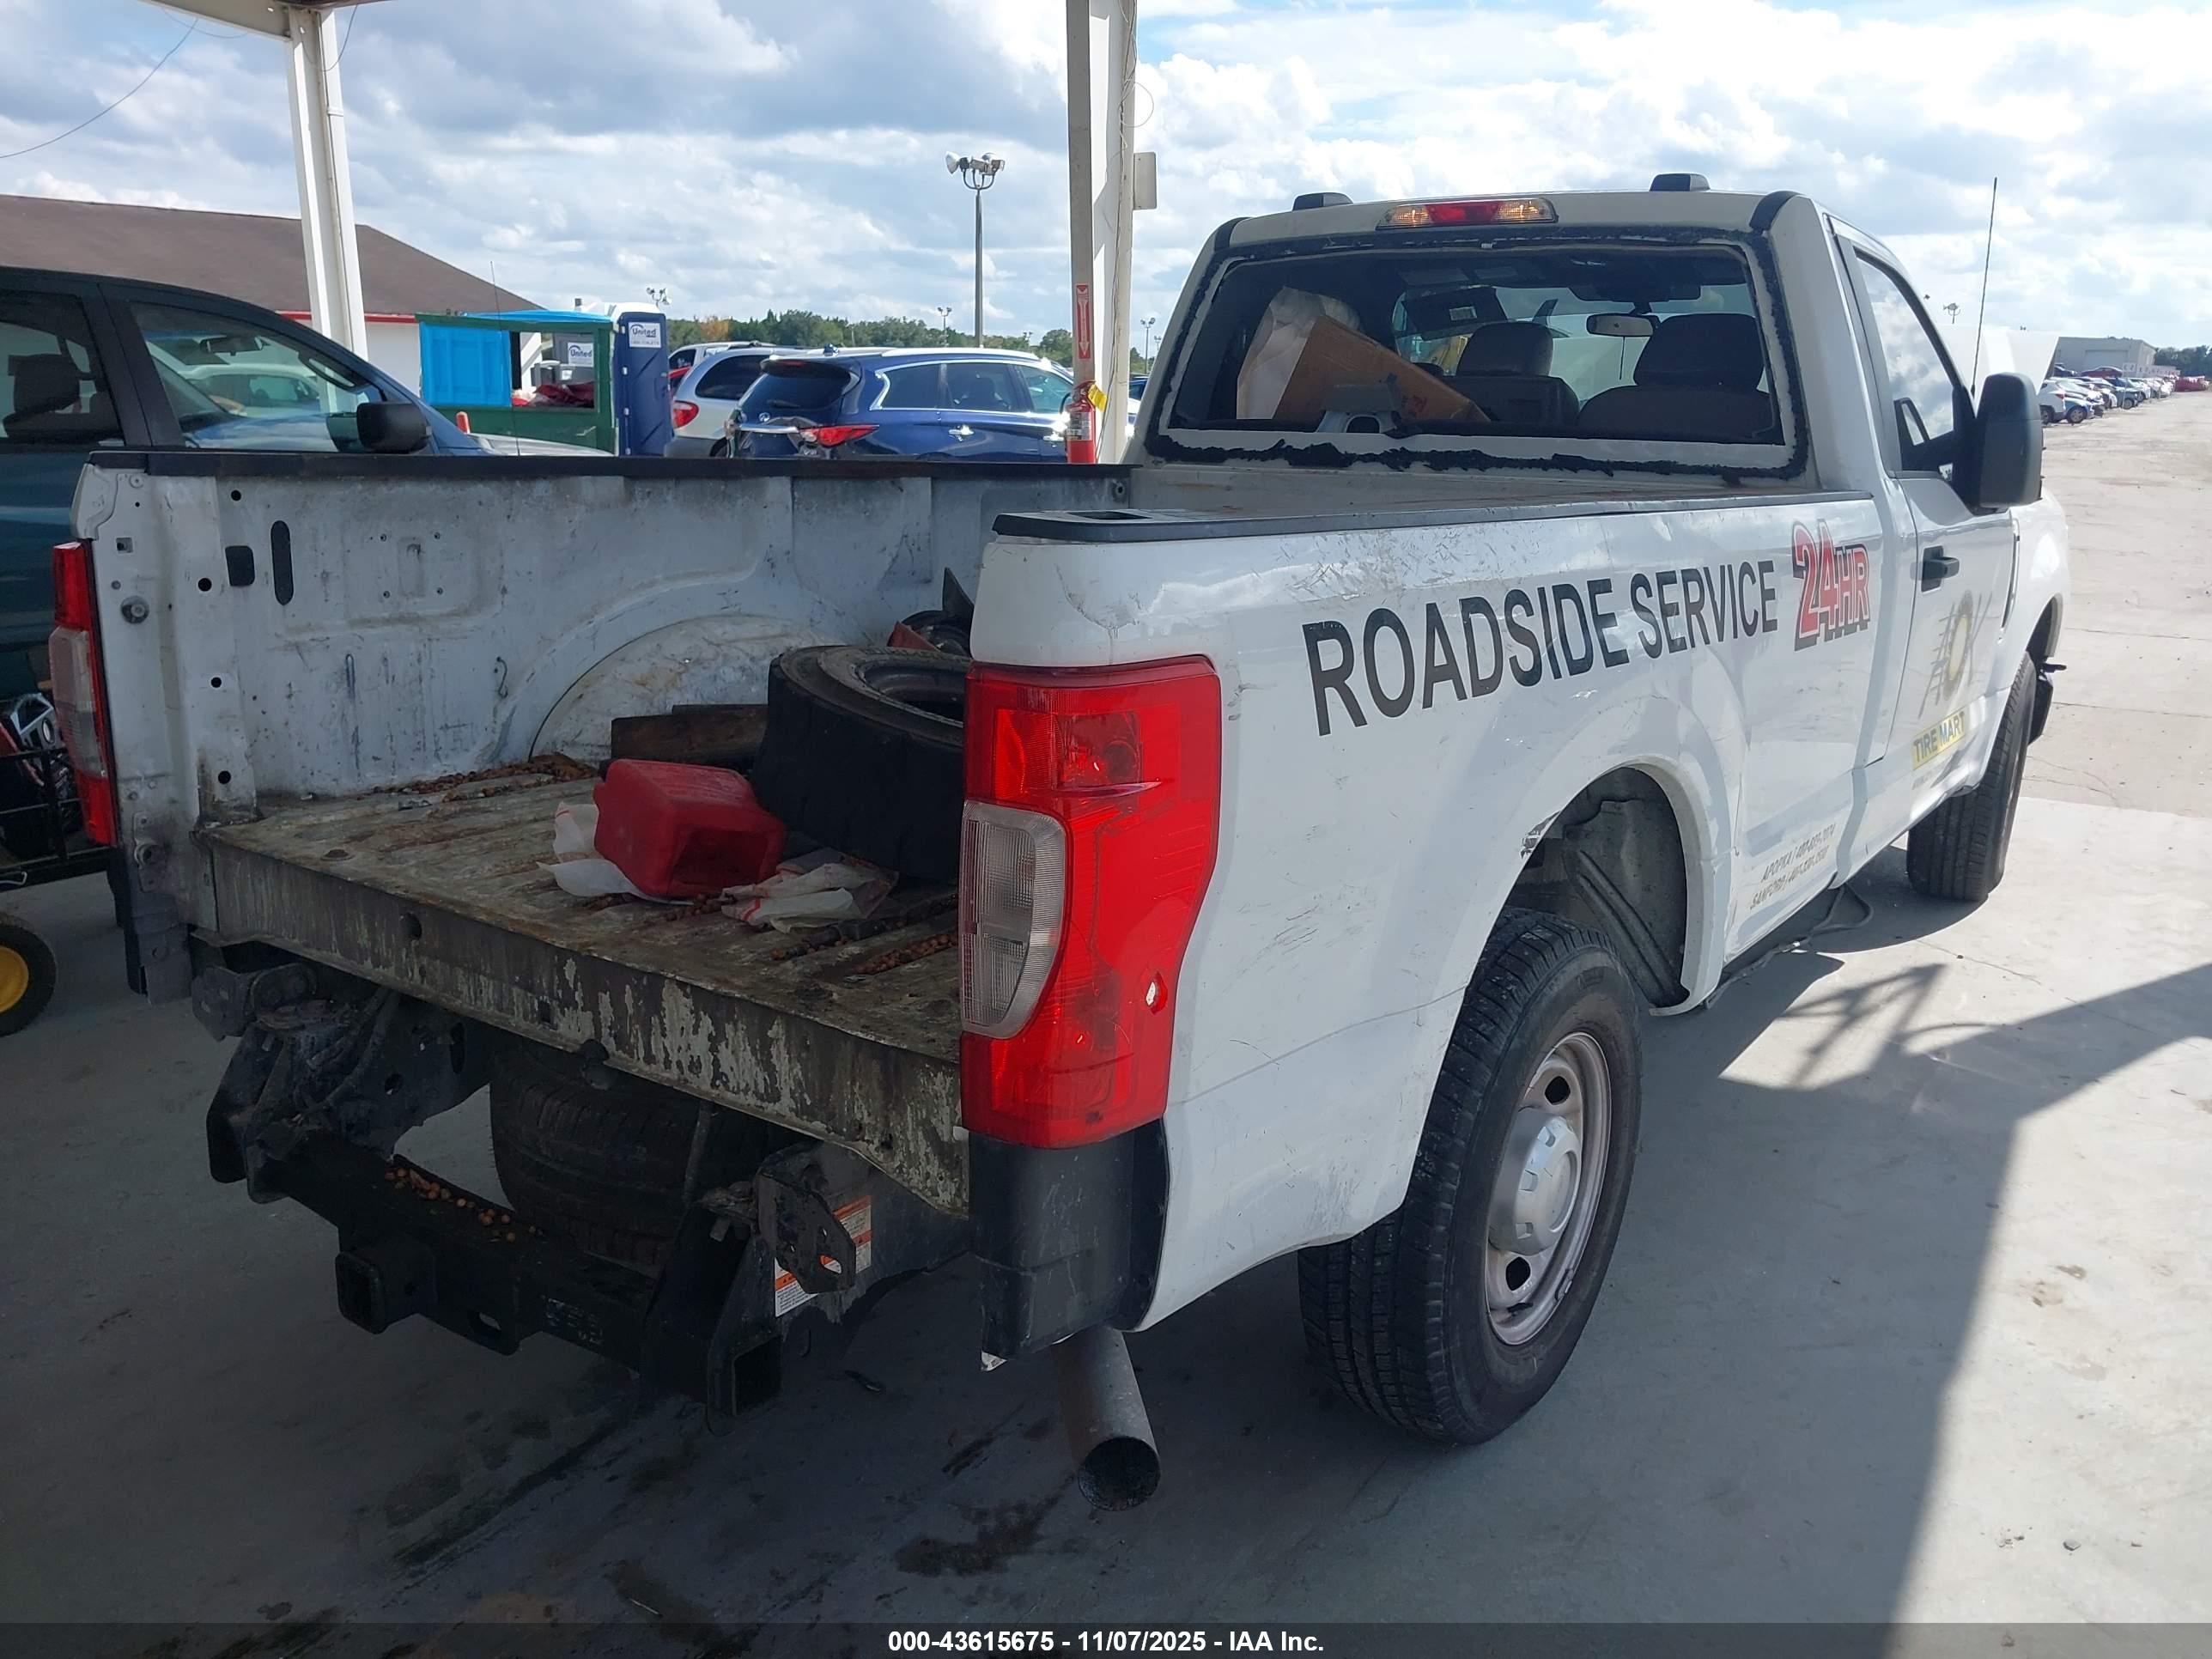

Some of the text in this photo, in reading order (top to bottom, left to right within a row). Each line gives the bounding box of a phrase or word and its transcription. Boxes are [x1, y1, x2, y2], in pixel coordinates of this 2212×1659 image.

[1302, 518, 1871, 736] ROADSIDE SERVICE 24HR
[1913, 711, 1965, 763] TIRE MART
